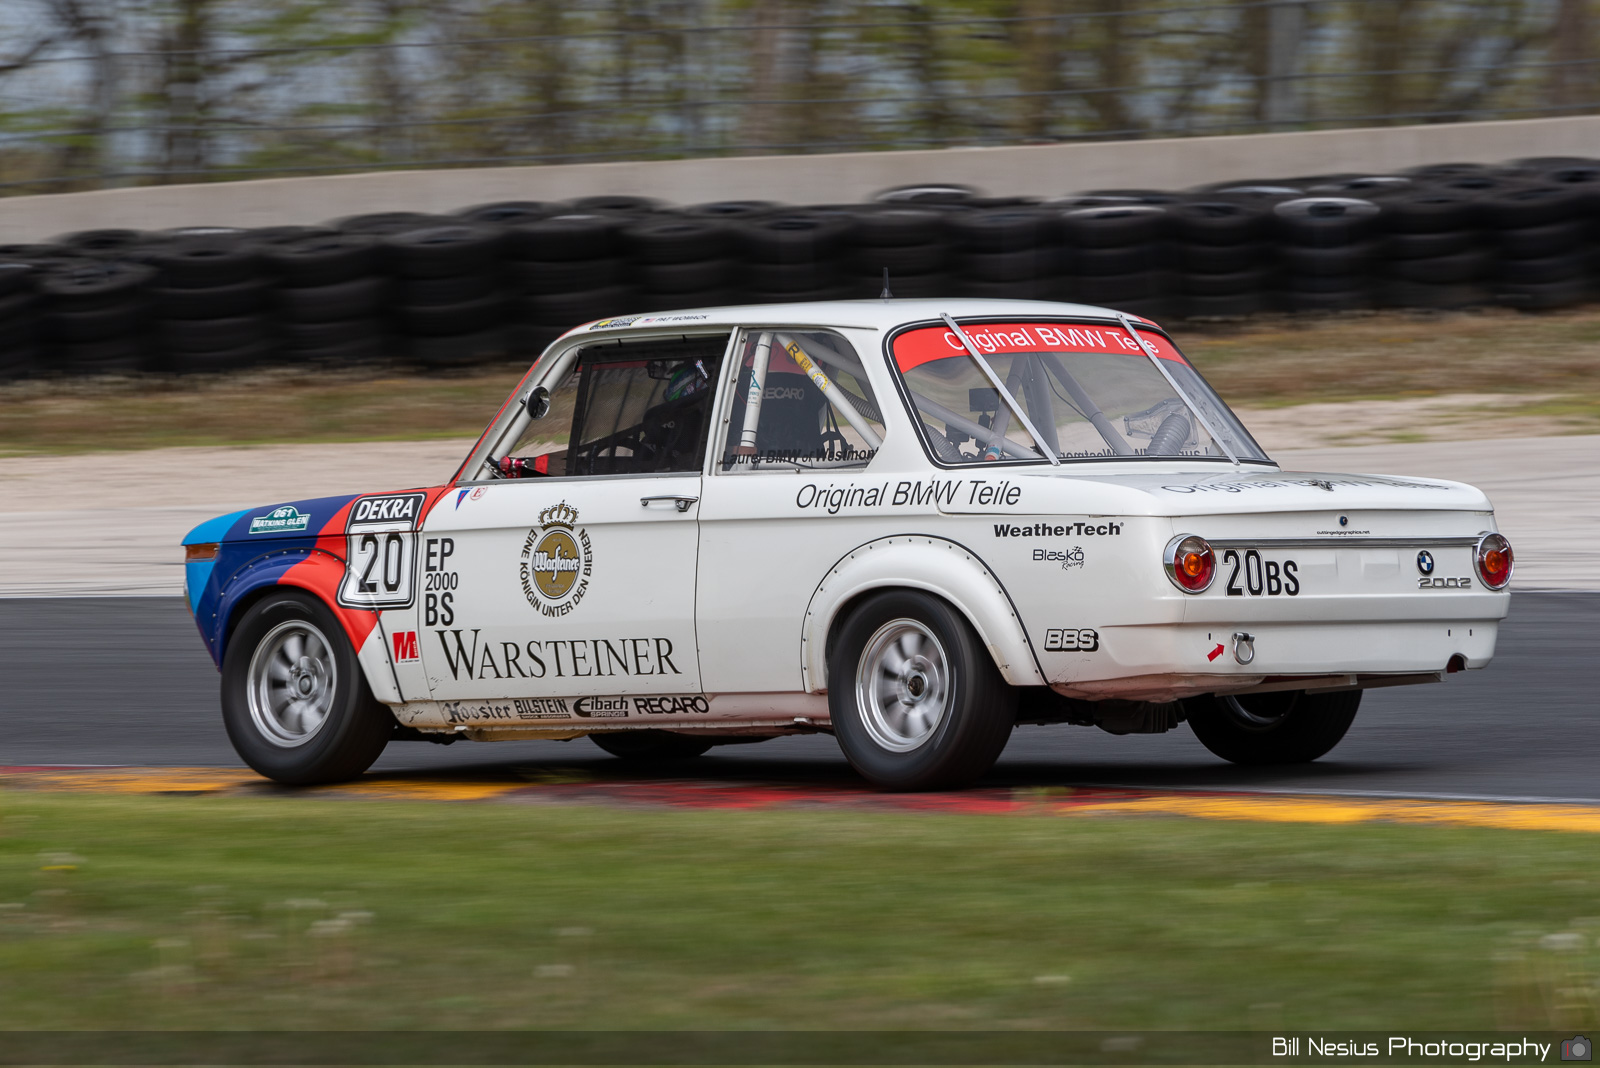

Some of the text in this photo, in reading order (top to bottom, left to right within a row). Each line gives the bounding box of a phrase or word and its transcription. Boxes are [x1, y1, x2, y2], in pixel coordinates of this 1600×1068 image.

[1035, 327, 1107, 348] BMW
[1105, 331, 1159, 354] Tee
[762, 387, 804, 400] ECARO
[722, 447, 764, 465] Laurel
[766, 449, 802, 464] BMW
[802, 451, 813, 463] of
[795, 480, 1022, 514] Original BMW Teile
[273, 508, 293, 518] 061
[355, 497, 414, 521] DEKRA
[252, 519, 286, 528] WATKINS
[286, 517, 307, 526] GLEN
[426, 538, 455, 572] EP
[521, 528, 538, 559] EINE
[578, 528, 593, 577] BIEREN
[1033, 547, 1084, 561] Blasko
[357, 531, 404, 595] 20
[1061, 560, 1085, 570] Racing
[1222, 549, 1300, 597] 20BS
[425, 572, 458, 591] 2000
[520, 562, 542, 612] KÖNIGIN
[571, 579, 589, 605] DEN
[1417, 577, 1471, 590] 2002
[425, 591, 455, 627] BS
[541, 600, 574, 617] UNTER
[1044, 628, 1100, 652] BBS
[442, 700, 512, 723] Hoosier
[513, 698, 569, 714] BILSTEIN
[573, 696, 629, 717] Eibach
[633, 696, 709, 714] RECARO
